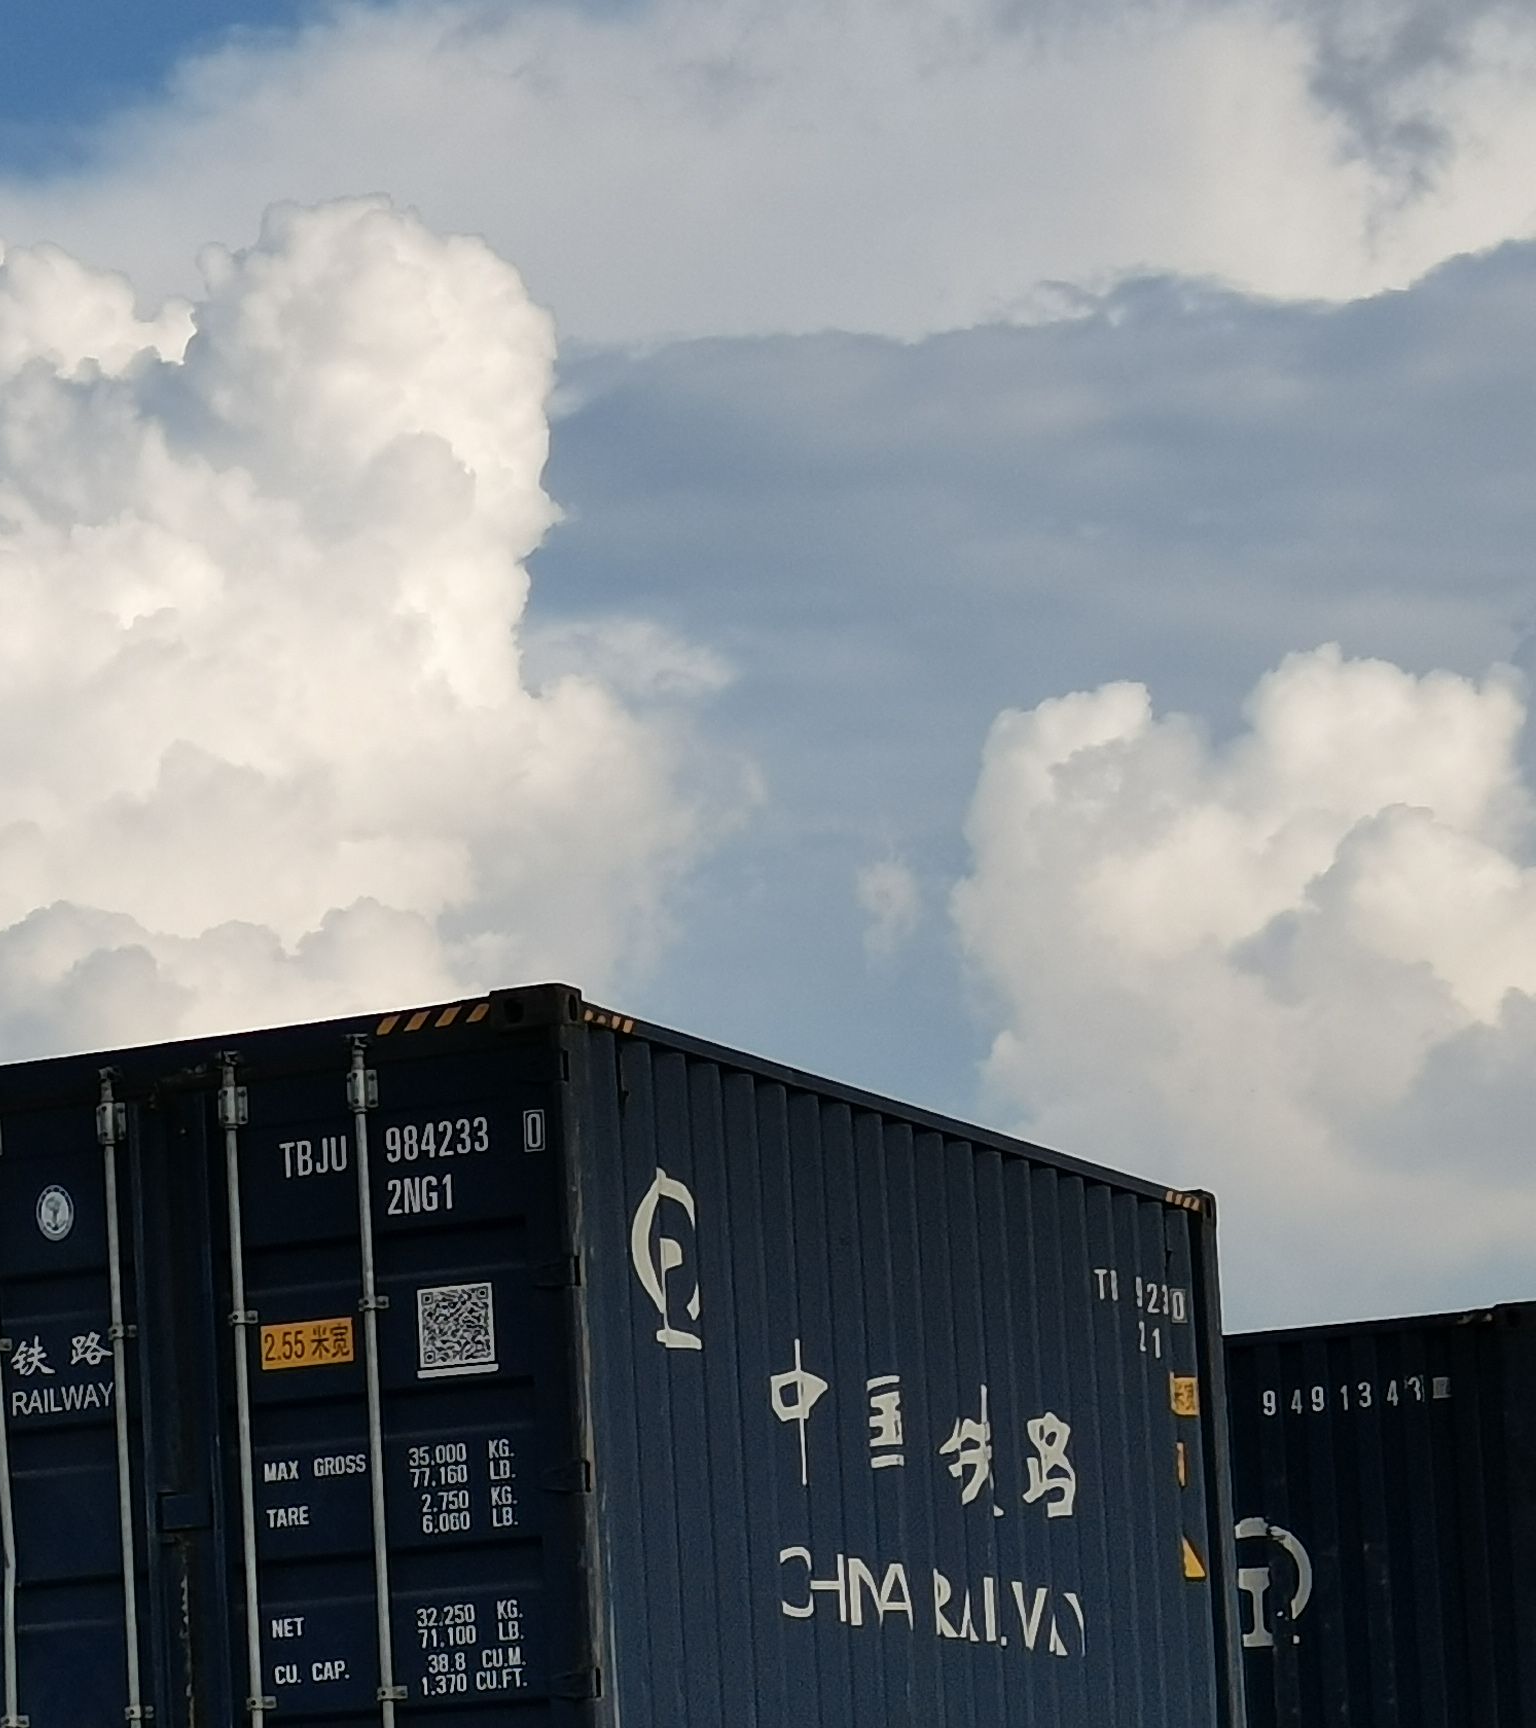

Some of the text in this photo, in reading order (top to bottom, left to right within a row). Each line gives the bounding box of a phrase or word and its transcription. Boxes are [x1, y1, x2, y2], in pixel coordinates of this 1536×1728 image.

[279, 1135, 348, 1179] TBJU
[386, 1116, 489, 1163] 984233
[387, 1173, 455, 1215] 2NG1
[264, 1323, 349, 1362] 2.55 米宽
[11, 1381, 115, 1418] RAILWAY
[263, 1438, 515, 1483] MAX GROSS 35.000 KG.
[410, 1464, 468, 1488] 77.160
[265, 1485, 518, 1529] TARE 2.750 KG.
[271, 1599, 524, 1640] NET 32.250 KG.
[418, 1621, 525, 1649] 71.100 LB.
[274, 1646, 527, 1685] CU. CAP. 38.8 CU.M.
[421, 1668, 528, 1697] 1.370 CU.FT.
